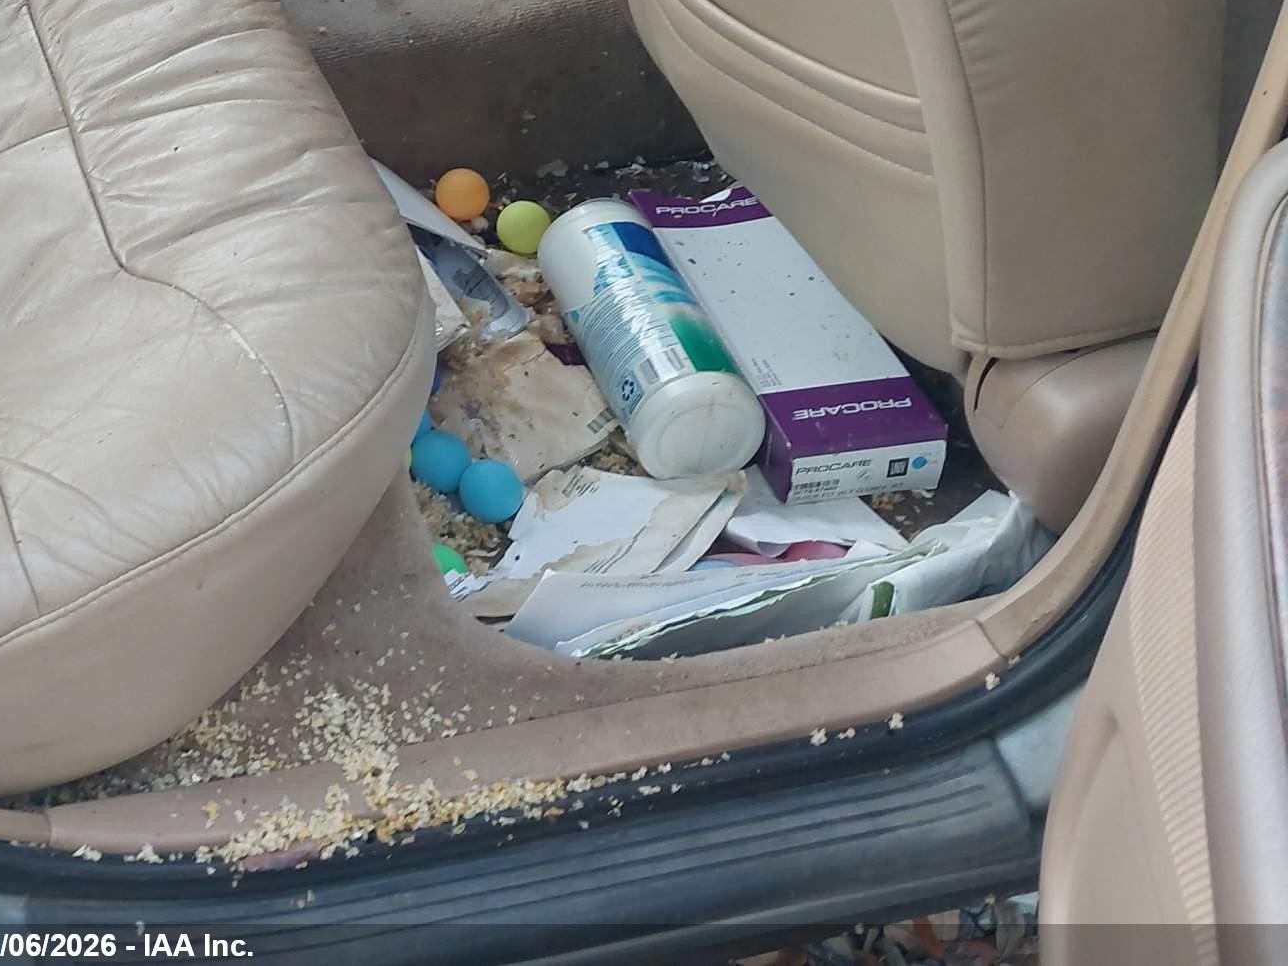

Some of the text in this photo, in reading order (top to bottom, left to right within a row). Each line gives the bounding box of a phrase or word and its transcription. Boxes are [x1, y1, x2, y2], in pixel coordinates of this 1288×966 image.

[655, 196, 759, 218] PROCARE
[792, 397, 912, 421] PROCARE
[795, 459, 872, 476] PROCARE
